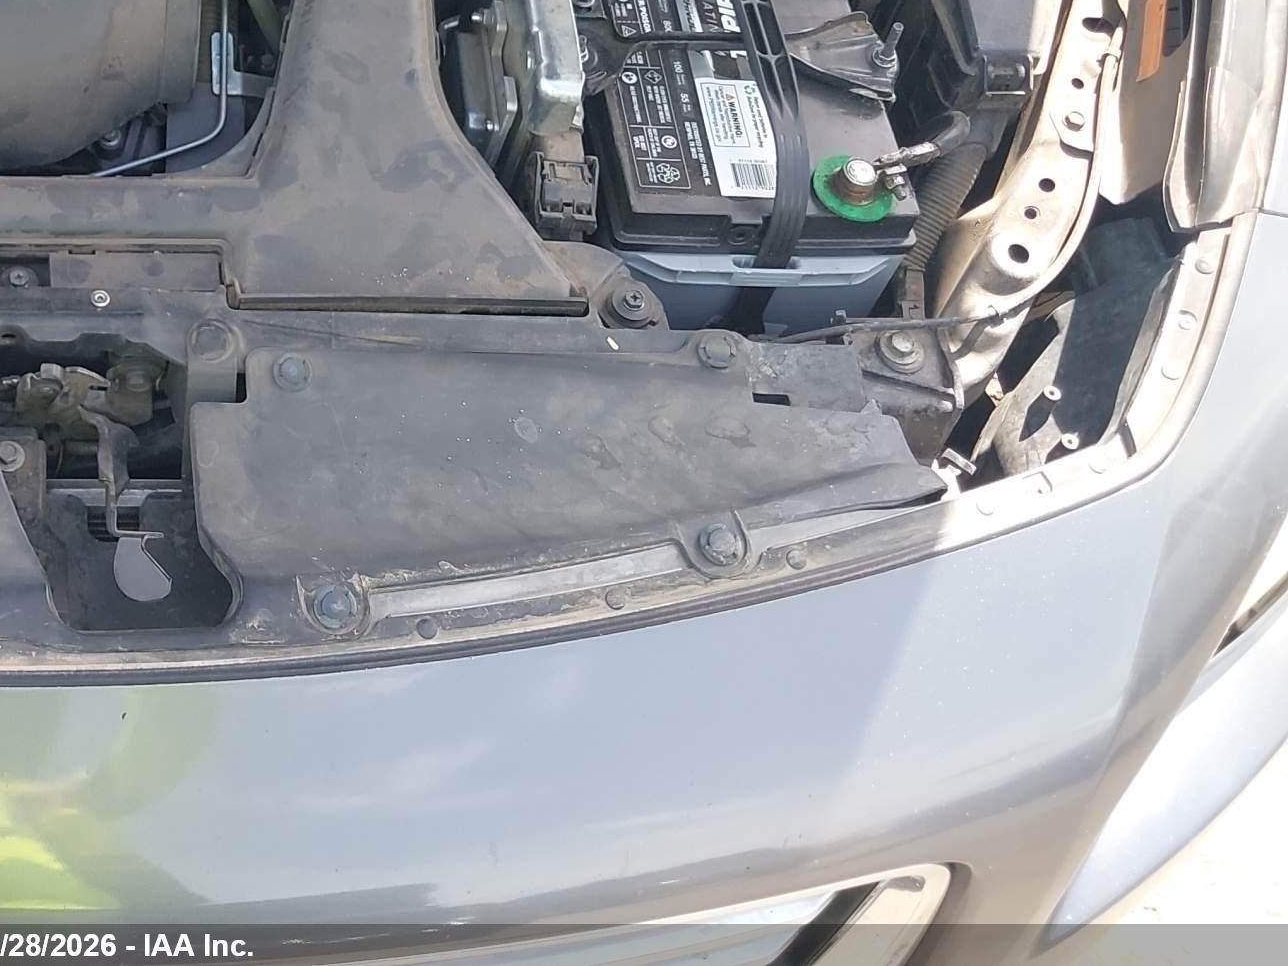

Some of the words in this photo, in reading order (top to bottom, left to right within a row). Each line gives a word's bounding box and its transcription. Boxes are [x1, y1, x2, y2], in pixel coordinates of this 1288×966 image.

[673, 61, 683, 74] 100
[680, 93, 689, 103] 55
[729, 102, 744, 139] WARNING:
